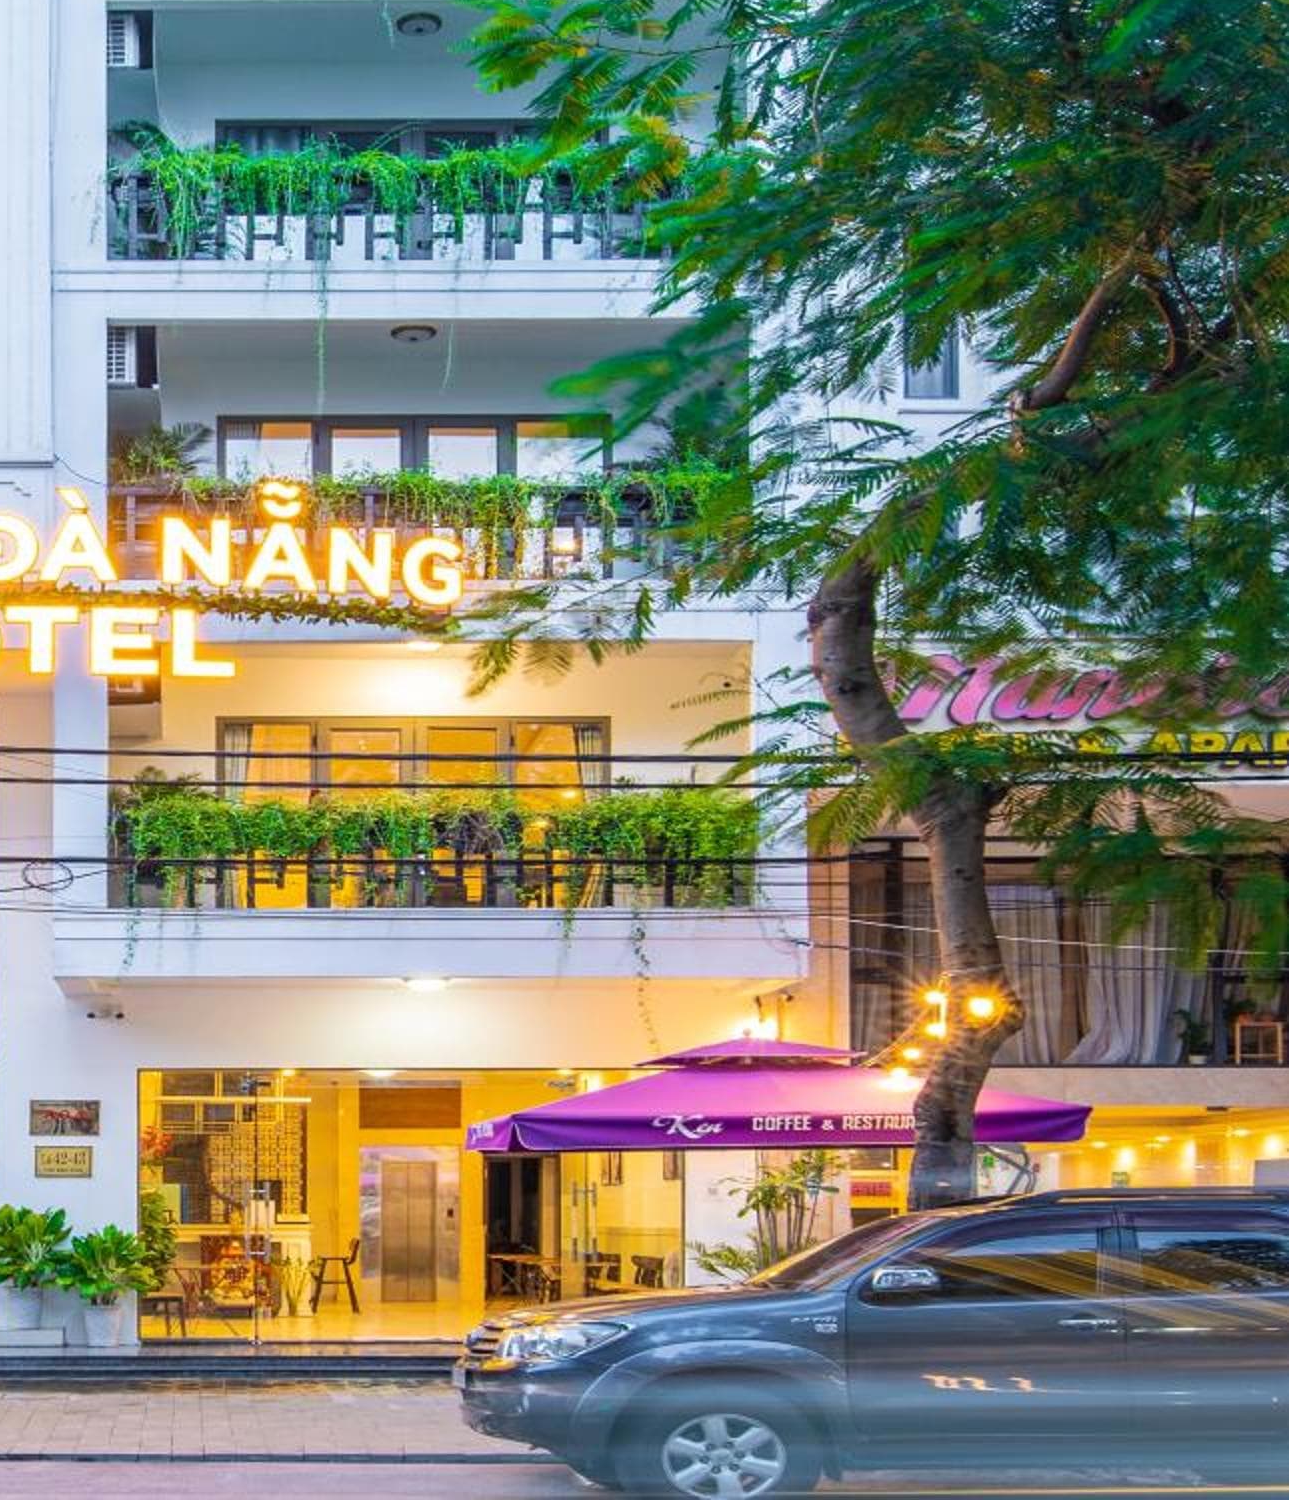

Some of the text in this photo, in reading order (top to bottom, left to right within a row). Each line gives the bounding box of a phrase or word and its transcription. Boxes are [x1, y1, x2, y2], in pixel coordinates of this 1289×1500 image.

[160, 480, 465, 606] NẴNG
[752, 1116, 812, 1131] COFFEE
[821, 1118, 834, 1131] &
[842, 1115, 916, 1131] RESTAUR
